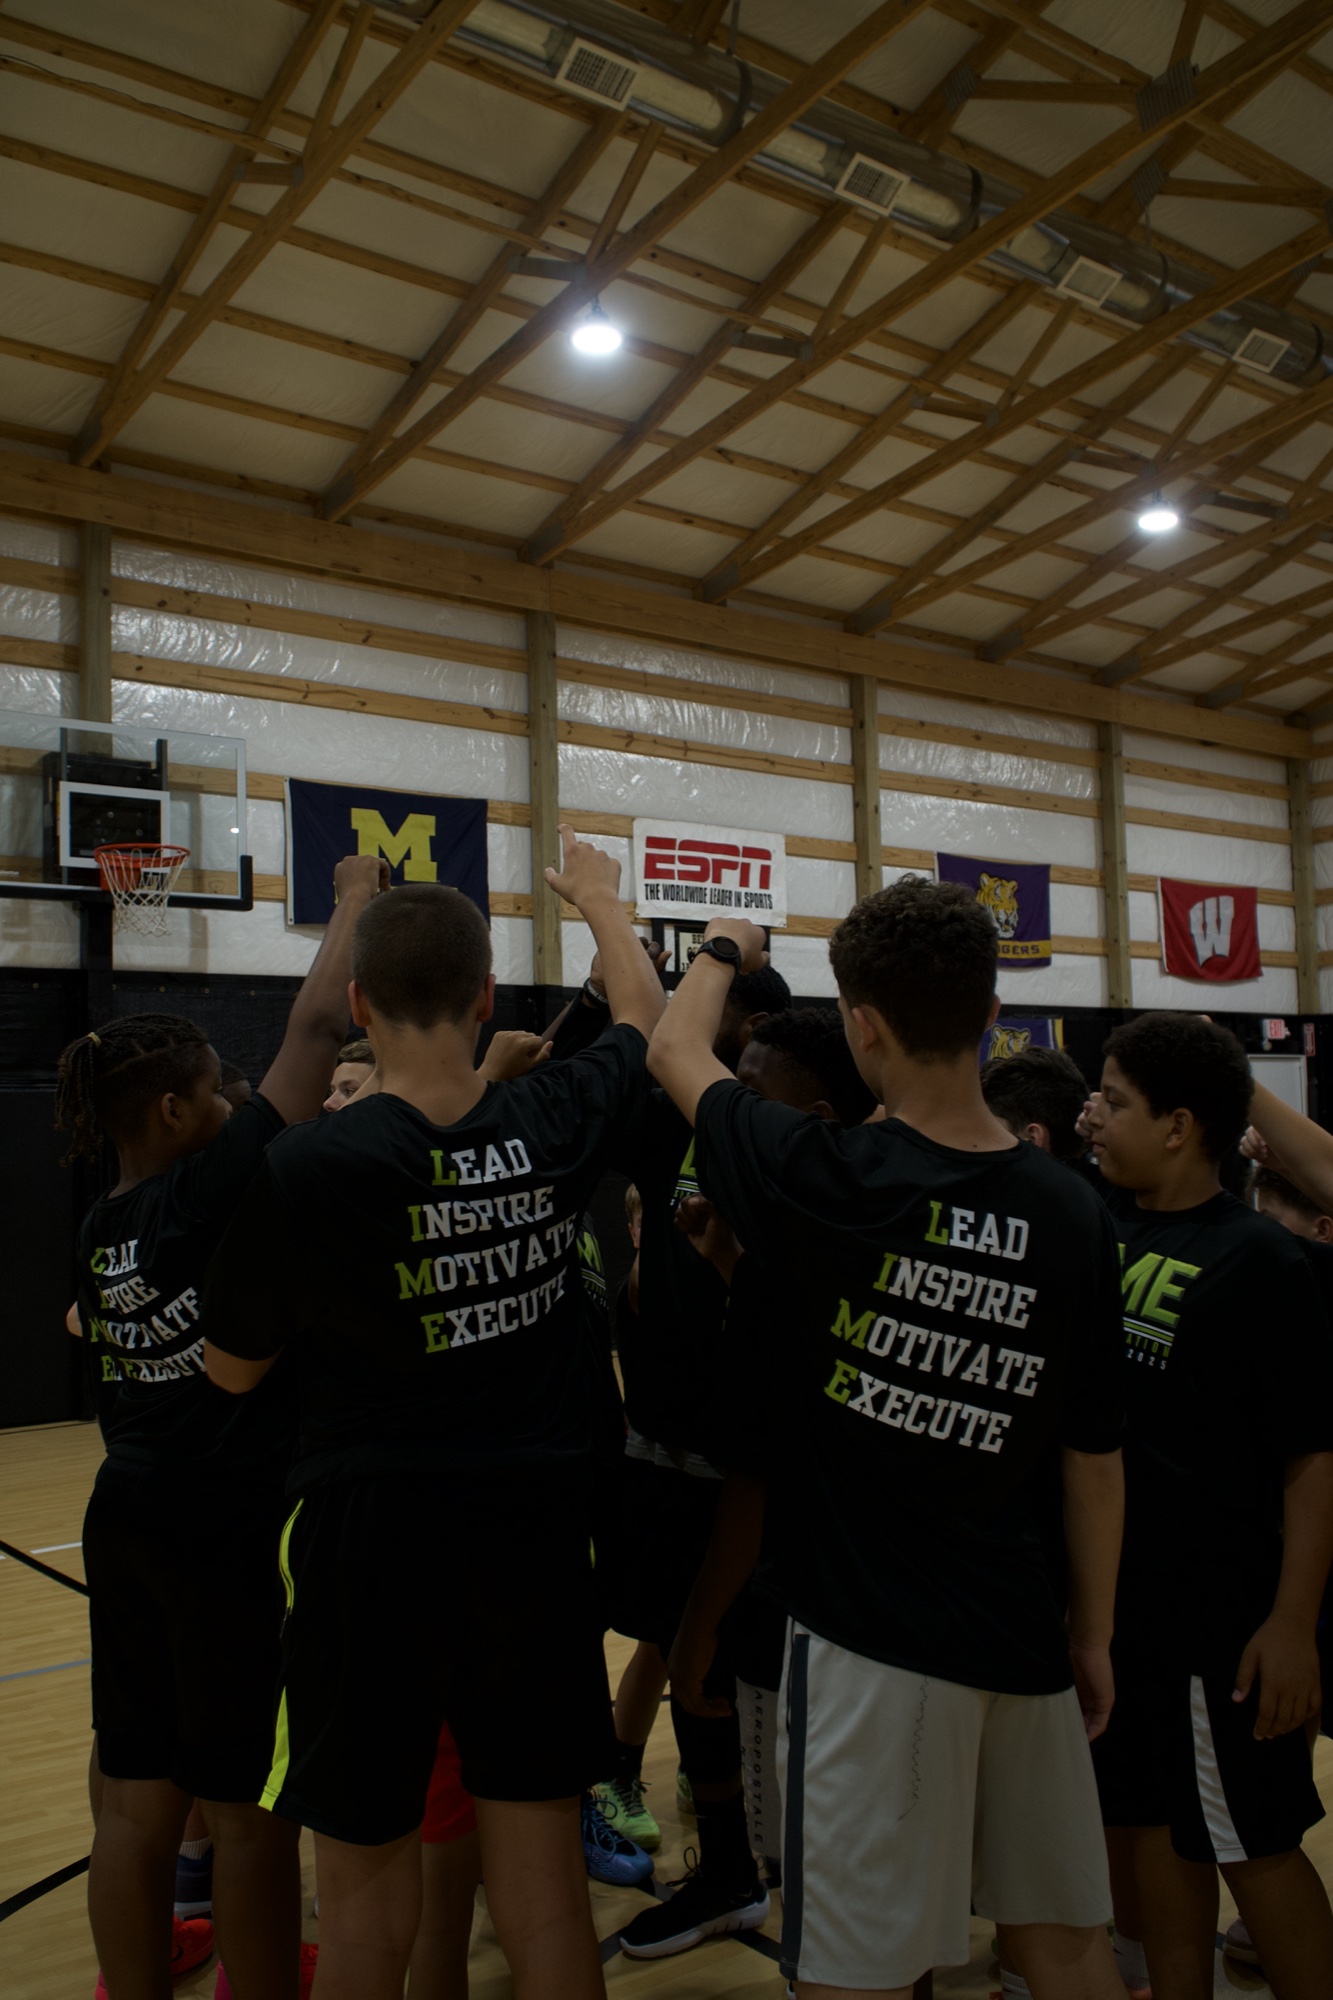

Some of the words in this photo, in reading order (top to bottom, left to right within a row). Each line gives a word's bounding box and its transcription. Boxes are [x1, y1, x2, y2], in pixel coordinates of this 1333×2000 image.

[351, 807, 438, 882] M
[644, 836, 772, 890] ESPN
[644, 883, 660, 900] THE
[662, 884, 707, 904] WORLDWIDE
[709, 887, 733, 907] LEADER
[734, 891, 742, 908] IN
[744, 892, 773, 910] SPORTS
[1189, 895, 1235, 967] W
[429, 1138, 533, 1187] LEAD
[407, 1185, 555, 1243] INSPIRE
[924, 1199, 1030, 1262] LEAD
[394, 1211, 578, 1300] MOTIVATE
[872, 1252, 1038, 1330] INSPIRE
[1116, 1242, 1204, 1330] ME
[420, 1265, 568, 1354] EXECUTE
[1125, 1333, 1171, 1358] ATION
[829, 1297, 1046, 1398] MOTIVATE
[823, 1358, 1013, 1455] EXECUTE
[753, 1690, 763, 1843] AEROPOSTALE
